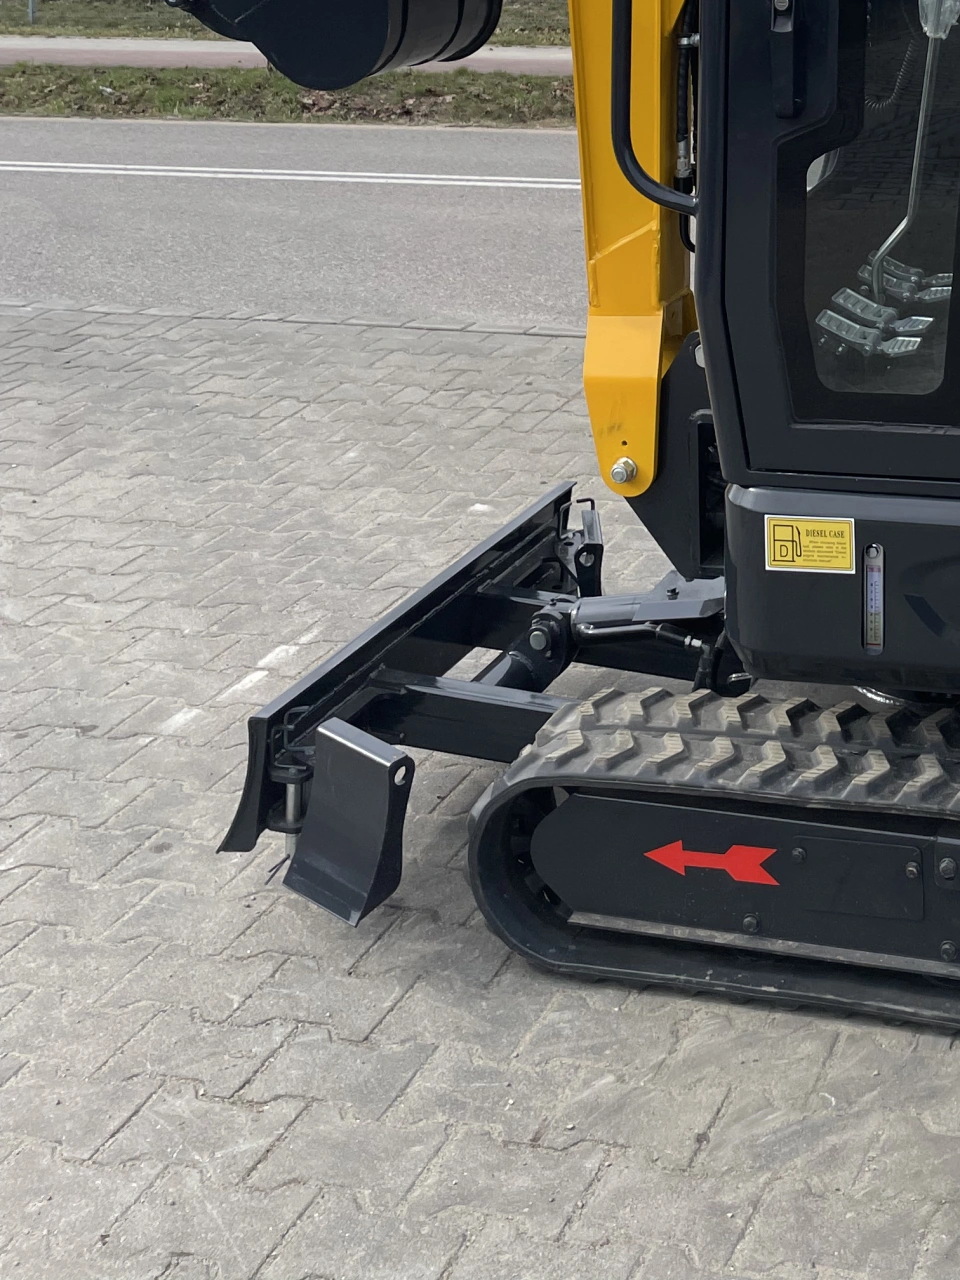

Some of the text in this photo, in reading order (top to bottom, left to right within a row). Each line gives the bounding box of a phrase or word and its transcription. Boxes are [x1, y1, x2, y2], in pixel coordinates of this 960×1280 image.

[805, 529, 845, 538] DIESEL CASE
[780, 545, 788, 557] D
